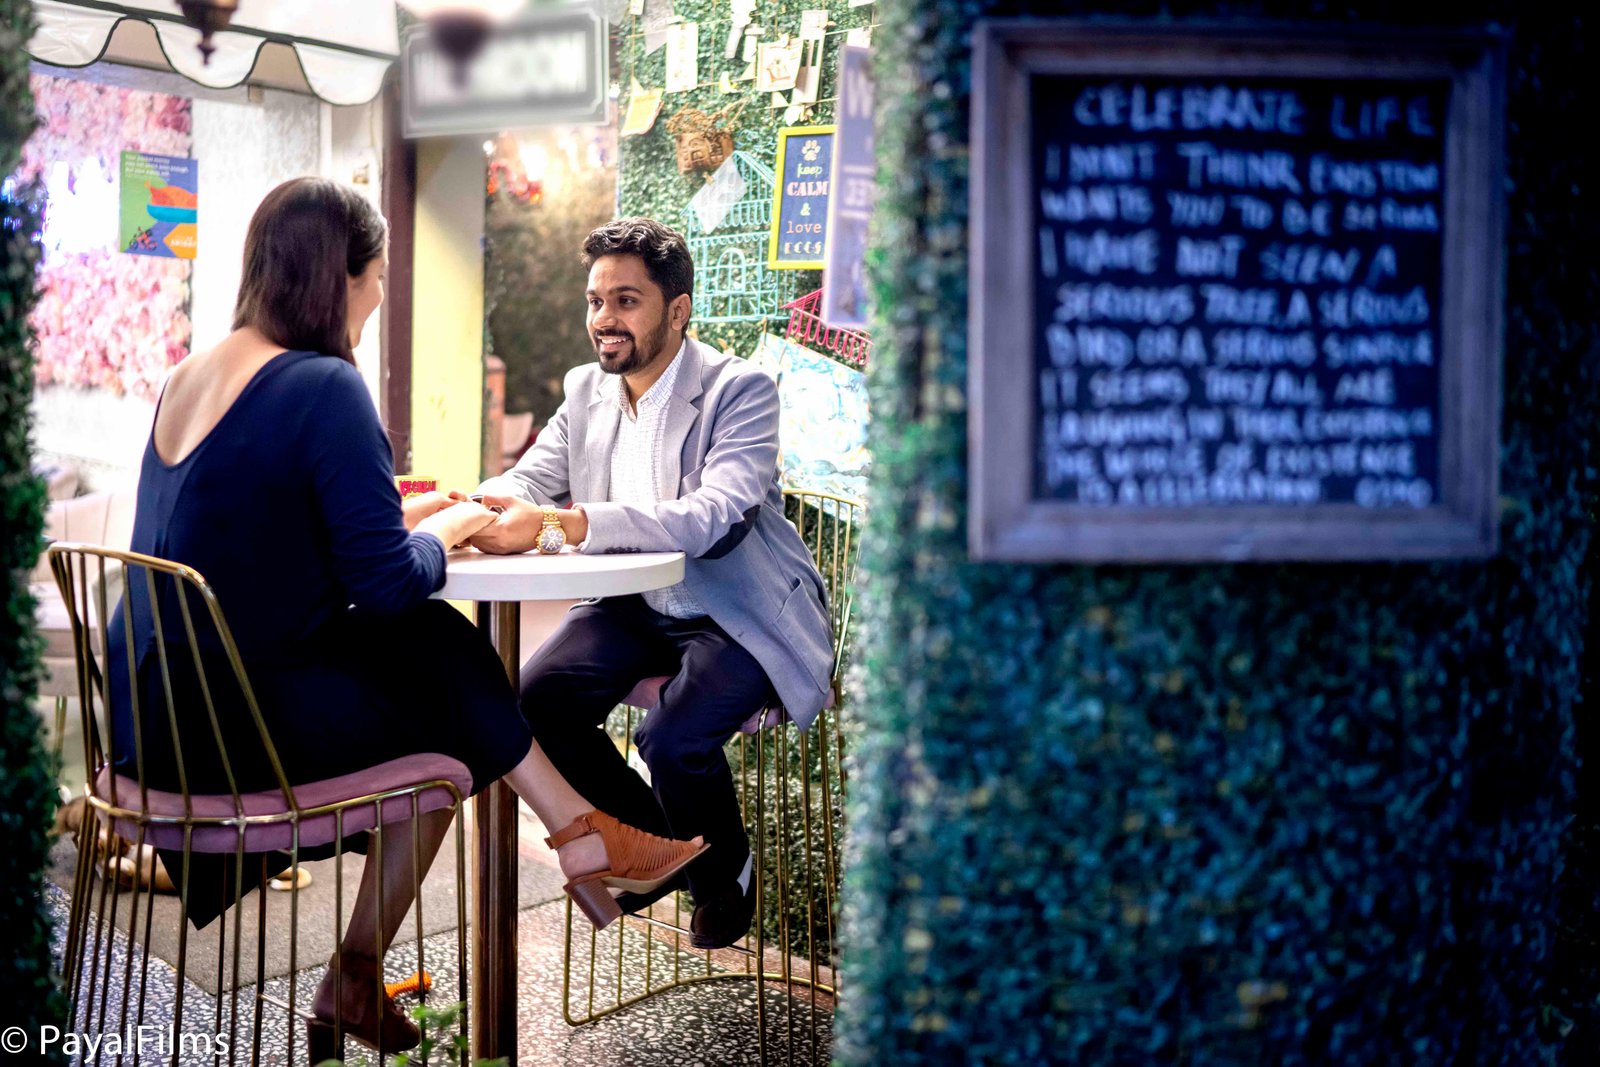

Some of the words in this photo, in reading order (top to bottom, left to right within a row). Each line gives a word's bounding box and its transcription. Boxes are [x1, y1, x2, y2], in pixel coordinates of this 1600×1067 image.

[1074, 85, 1306, 134] CELEBRATE
[1331, 94, 1436, 139] LIFE
[797, 163, 823, 178] keep
[1177, 142, 1302, 194] THINK
[786, 181, 830, 197] CALM
[800, 203, 811, 216] &
[786, 221, 823, 234] love
[1041, 185, 1154, 223] WANTS
[1166, 192, 1226, 227] YOU
[1230, 195, 1273, 230] TO
[1282, 198, 1331, 237] BE
[1039, 226, 1058, 279] I
[1064, 228, 1159, 276] HAVE
[1176, 234, 1245, 279] NOT
[1259, 240, 1362, 286] SEEN
[1366, 243, 1398, 287] A
[1285, 289, 1312, 328] A
[1318, 284, 1431, 329] SERIOUS
[1212, 329, 1317, 368] SERIOUS
[1040, 367, 1079, 408] IT
[1089, 368, 1191, 407] SEEMS
[1200, 368, 1269, 407] THEY
[1334, 367, 1396, 404] ARE
